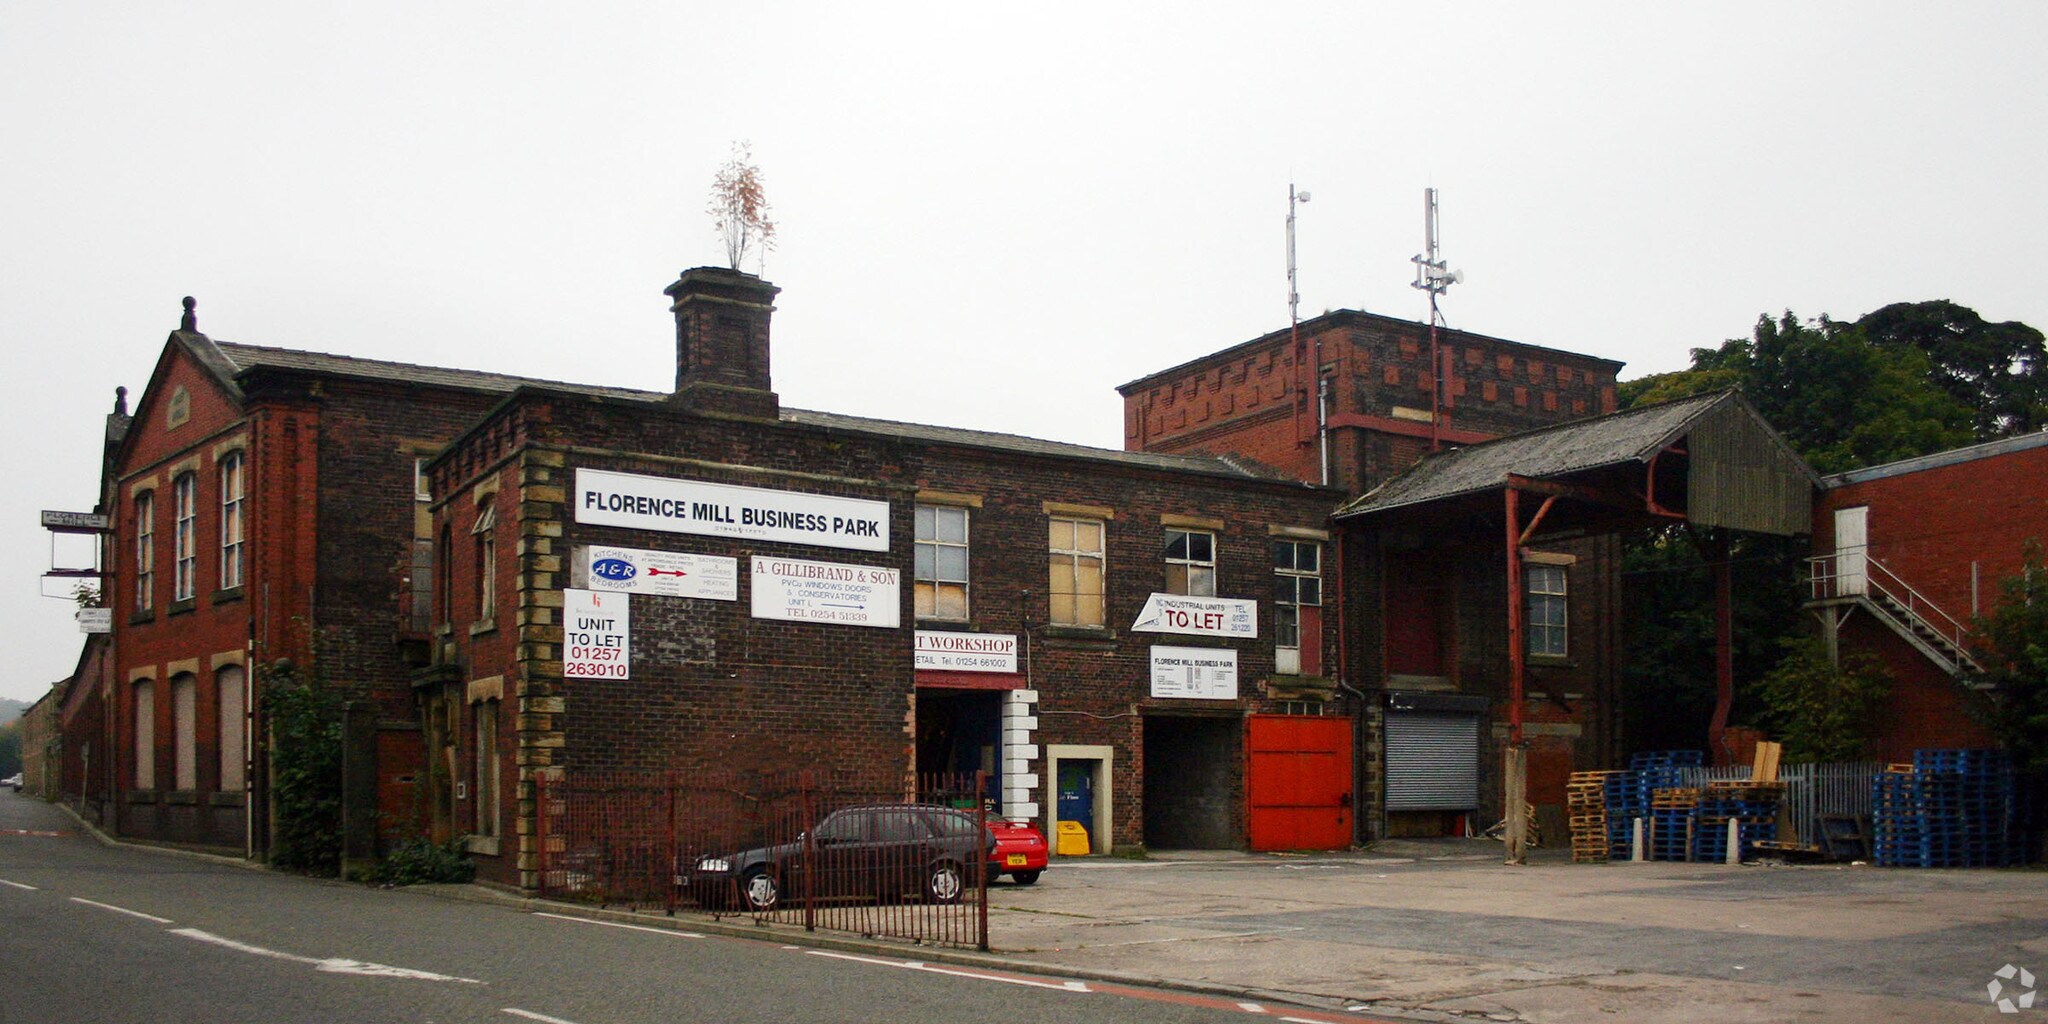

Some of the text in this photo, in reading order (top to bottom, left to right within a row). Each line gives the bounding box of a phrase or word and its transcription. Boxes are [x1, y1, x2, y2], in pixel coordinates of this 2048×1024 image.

[586, 491, 686, 519] FLORENCE
[693, 502, 735, 524] MILL
[742, 507, 828, 533] BUSINESS
[833, 517, 880, 538] PARK
[593, 550, 634, 562] KITCHENS
[595, 563, 634, 577] A & R
[772, 562, 853, 581] GILLIBRAND
[857, 570, 866, 582] &
[870, 571, 896, 585] SON
[590, 575, 638, 589] BEDROOMS
[703, 580, 730, 588] HEATING
[805, 581, 843, 591] WINDOWS
[845, 584, 872, 593] DOORS
[697, 588, 735, 597] APPLIANCES
[798, 590, 867, 602] CONSERVATORIES
[1164, 600, 1204, 610] INDUSTRIAL
[1205, 602, 1225, 611] UNITS
[1235, 605, 1247, 613] TEL
[786, 608, 868, 621] TEL 0254 51339
[1165, 610, 1224, 630] TO LET
[578, 618, 615, 631] UNIT
[569, 633, 624, 647] TO LET
[929, 636, 1013, 652] WORKSHOP
[571, 646, 622, 661] 01257
[916, 655, 935, 665] ETAIL
[955, 657, 977, 666] 01254
[980, 658, 1007, 667] 661002
[1154, 658, 1180, 666] FLORENCE
[566, 662, 626, 677] 263010
